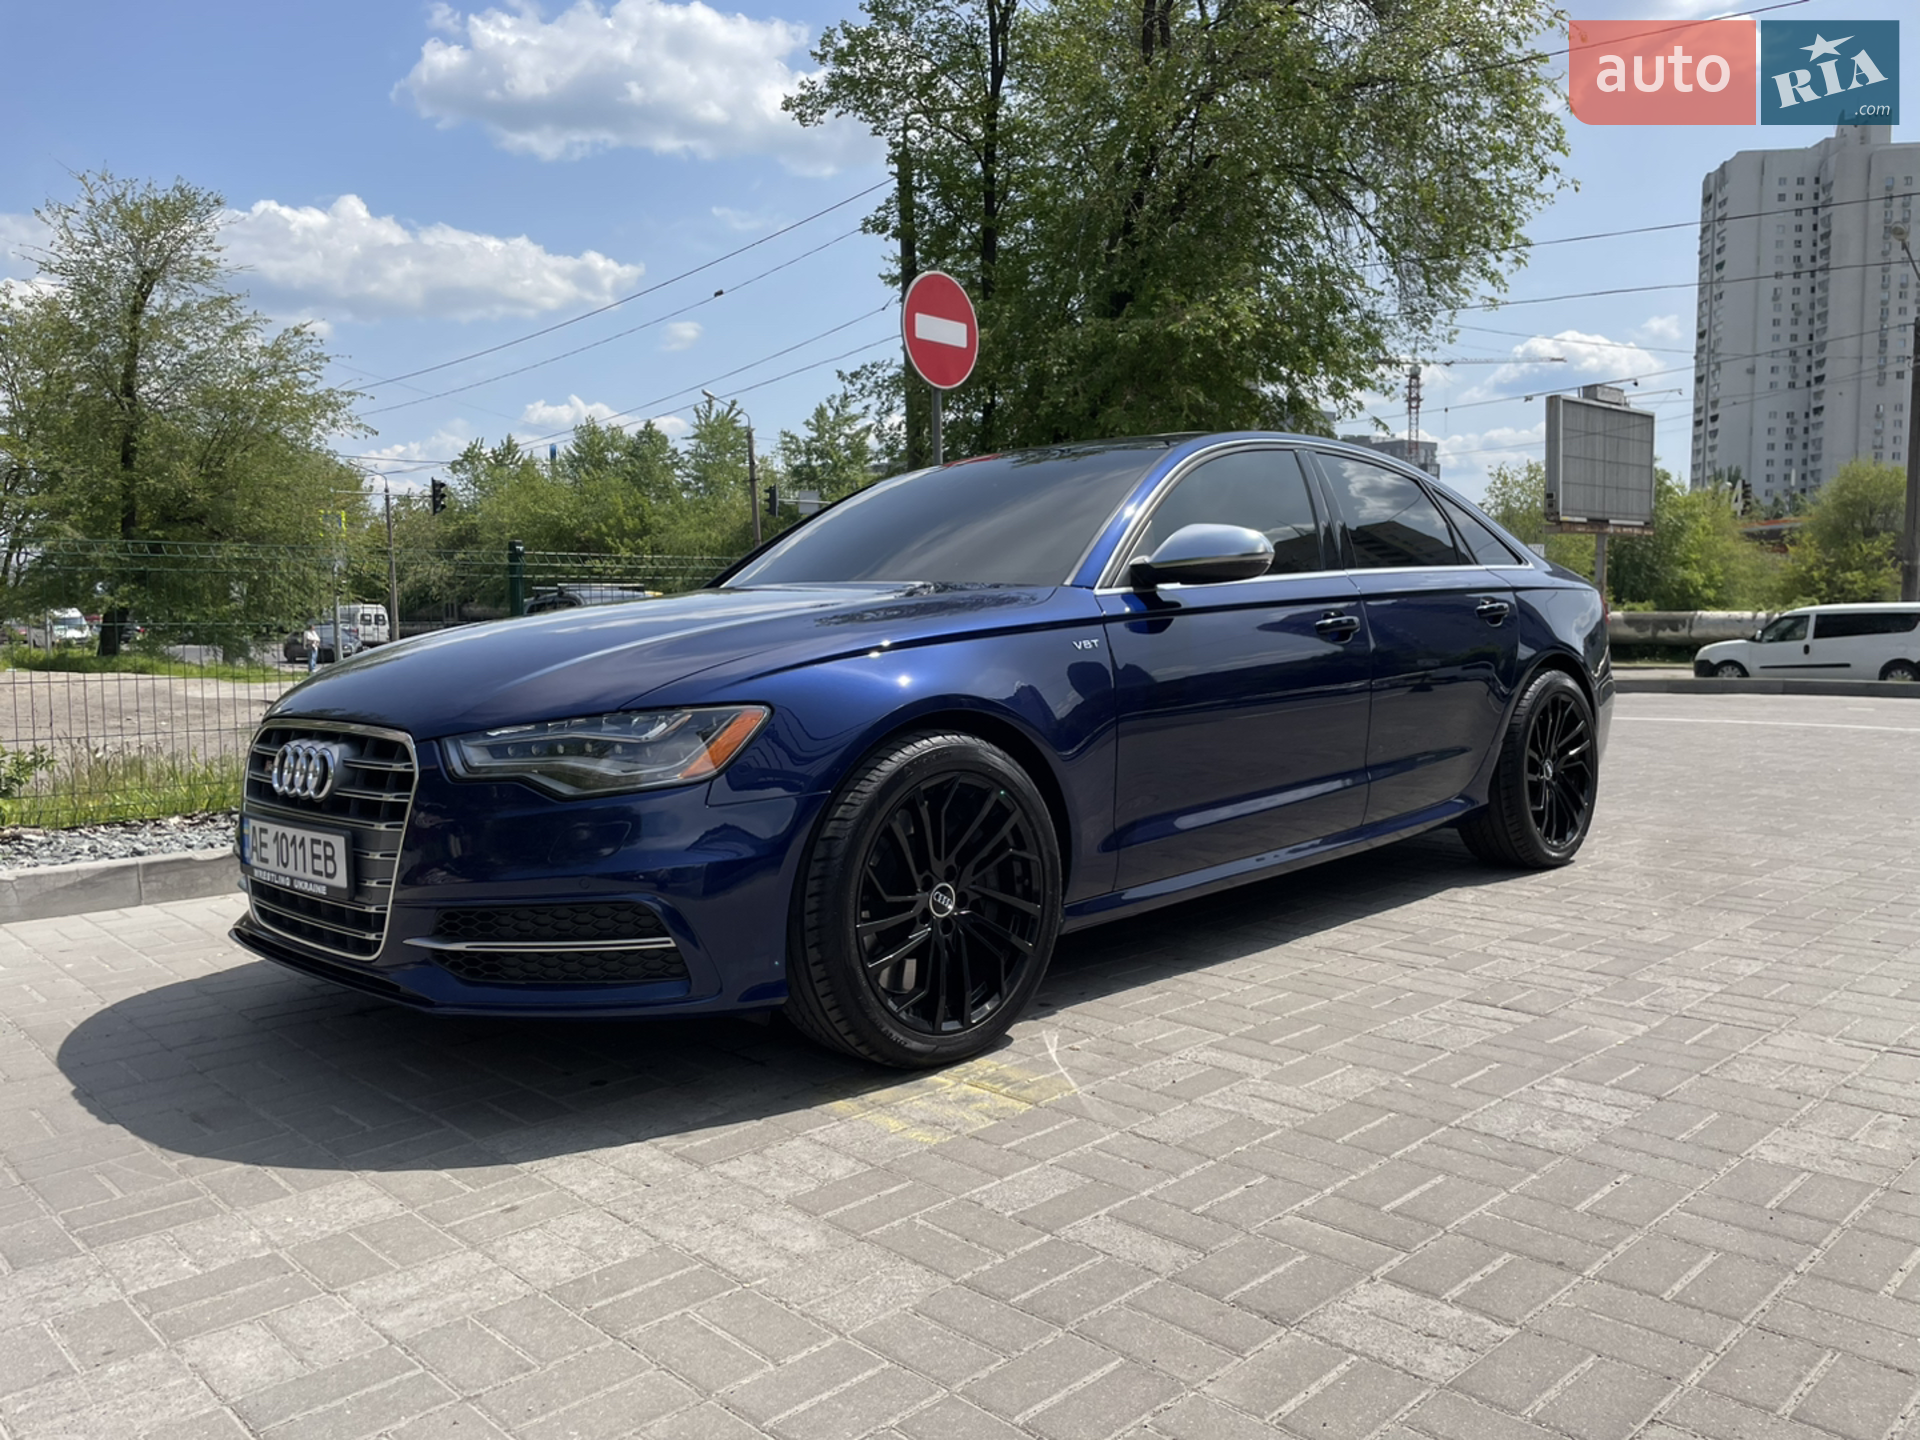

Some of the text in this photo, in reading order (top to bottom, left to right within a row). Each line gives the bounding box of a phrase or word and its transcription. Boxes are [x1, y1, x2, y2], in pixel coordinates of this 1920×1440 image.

[250, 825, 337, 880] AE 1011 EB
[293, 879, 328, 896] UKRAINE
